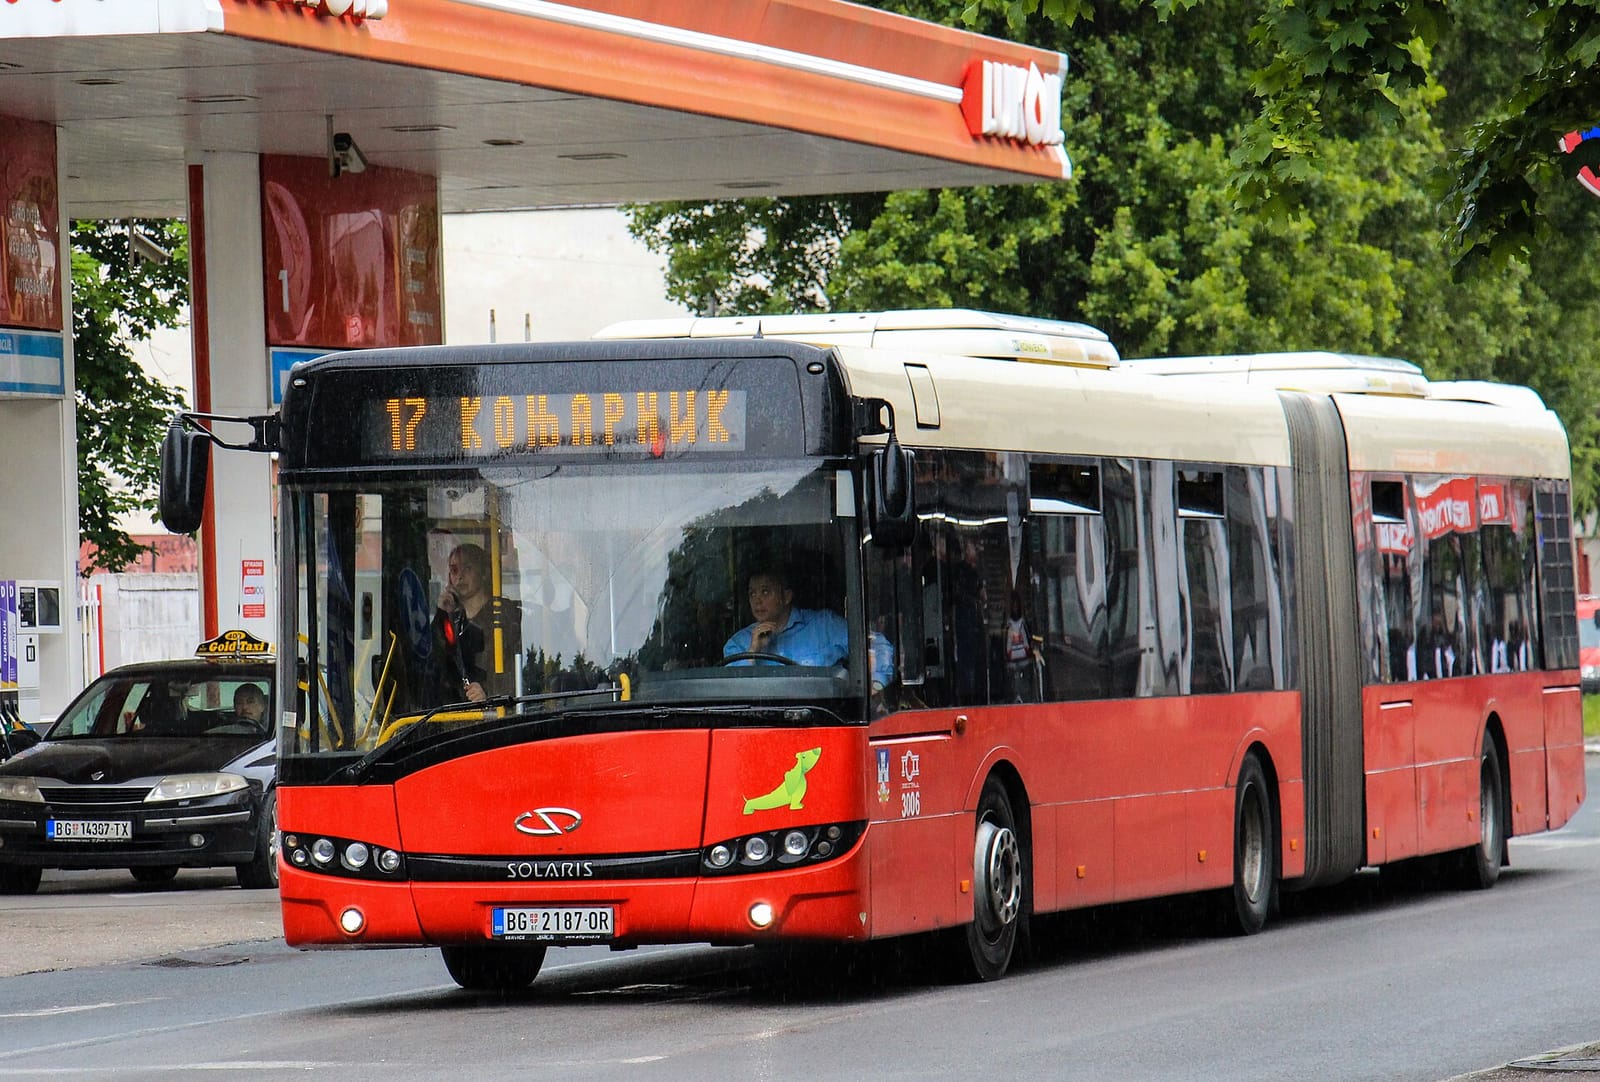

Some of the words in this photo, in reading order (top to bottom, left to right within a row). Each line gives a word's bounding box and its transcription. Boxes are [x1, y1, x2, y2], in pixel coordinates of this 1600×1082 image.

[385, 397, 426, 450] 17
[460, 390, 729, 449] КОЊАРНИК
[208, 641, 236, 652] Gold
[240, 641, 265, 651] Taxi
[901, 791, 920, 818] 3006
[56, 822, 72, 836] BG
[507, 862, 593, 878] SOLARIS
[507, 912, 527, 931] BG
